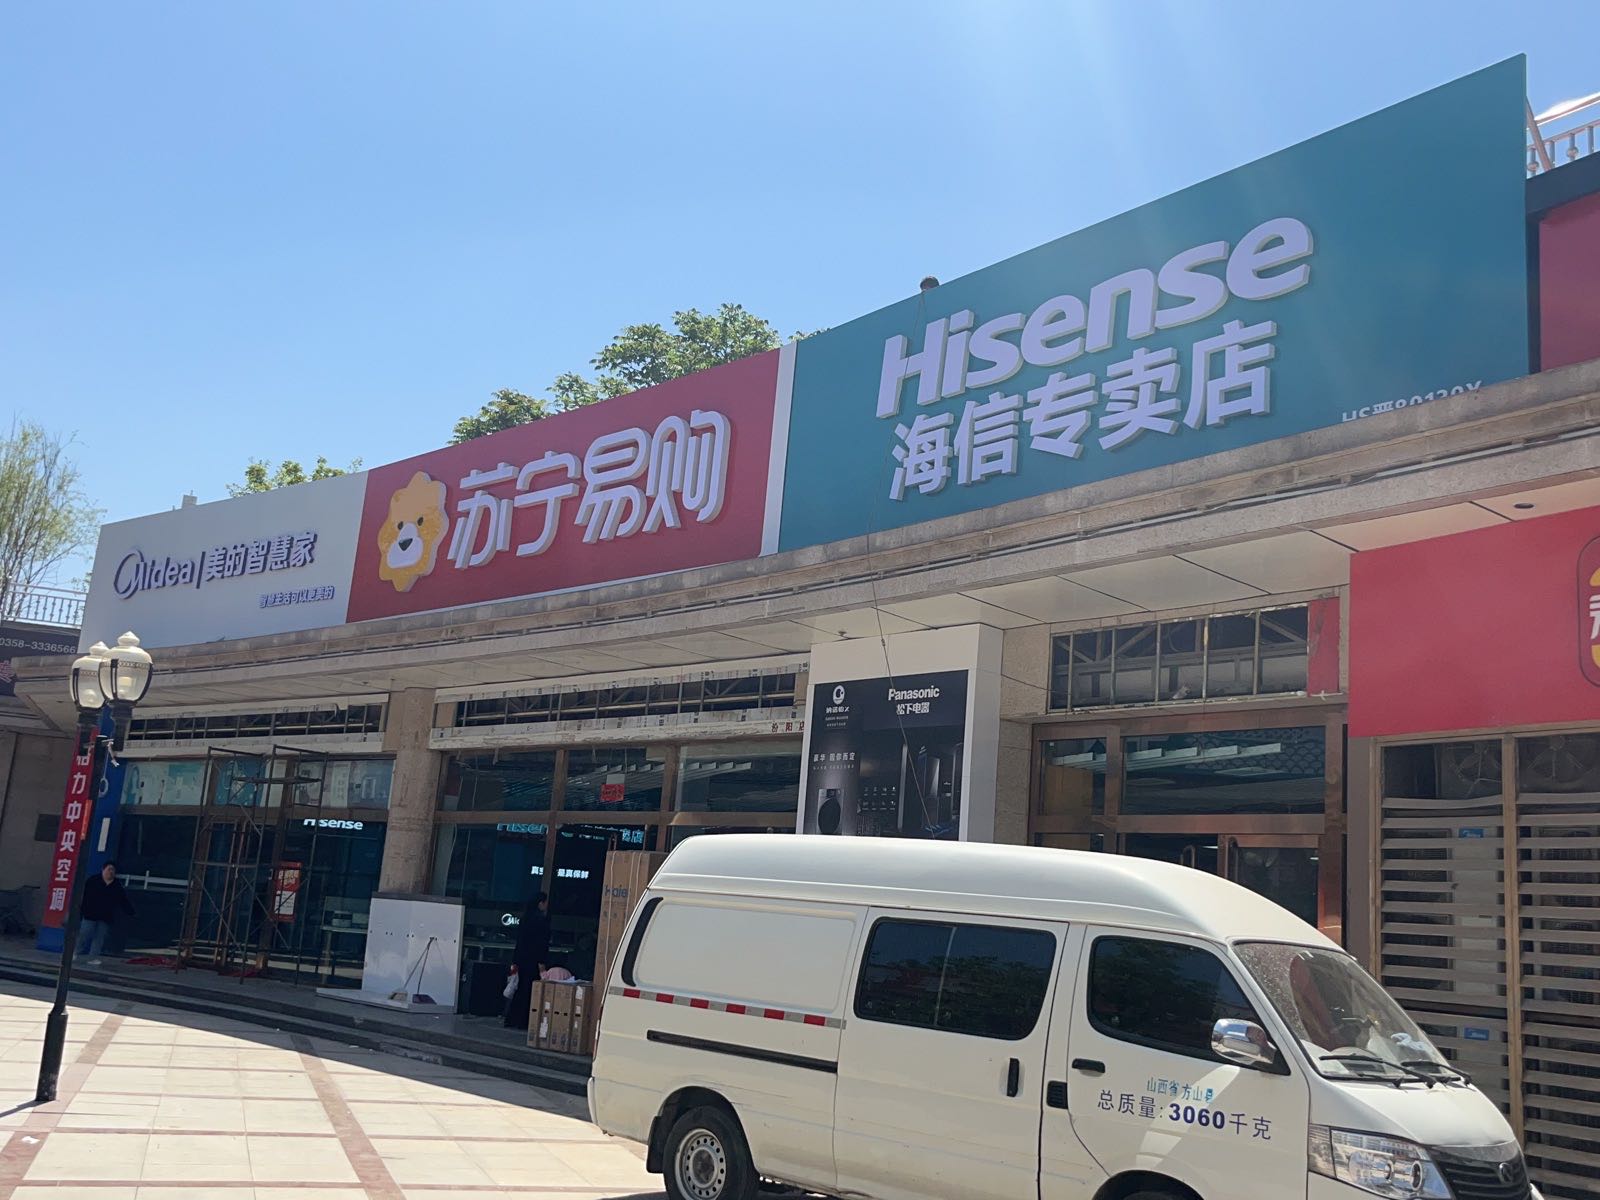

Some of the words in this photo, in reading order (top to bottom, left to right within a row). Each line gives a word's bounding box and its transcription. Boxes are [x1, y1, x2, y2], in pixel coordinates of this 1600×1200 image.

[876, 217, 1313, 419] Hisense
[889, 319, 1277, 501] 海信专卖店
[447, 409, 731, 569] 苏宁易购
[114, 546, 194, 600] Midea
[205, 531, 318, 582] 美的智慧家
[888, 685, 940, 701] Panasonic
[896, 702, 930, 715] 松下电器
